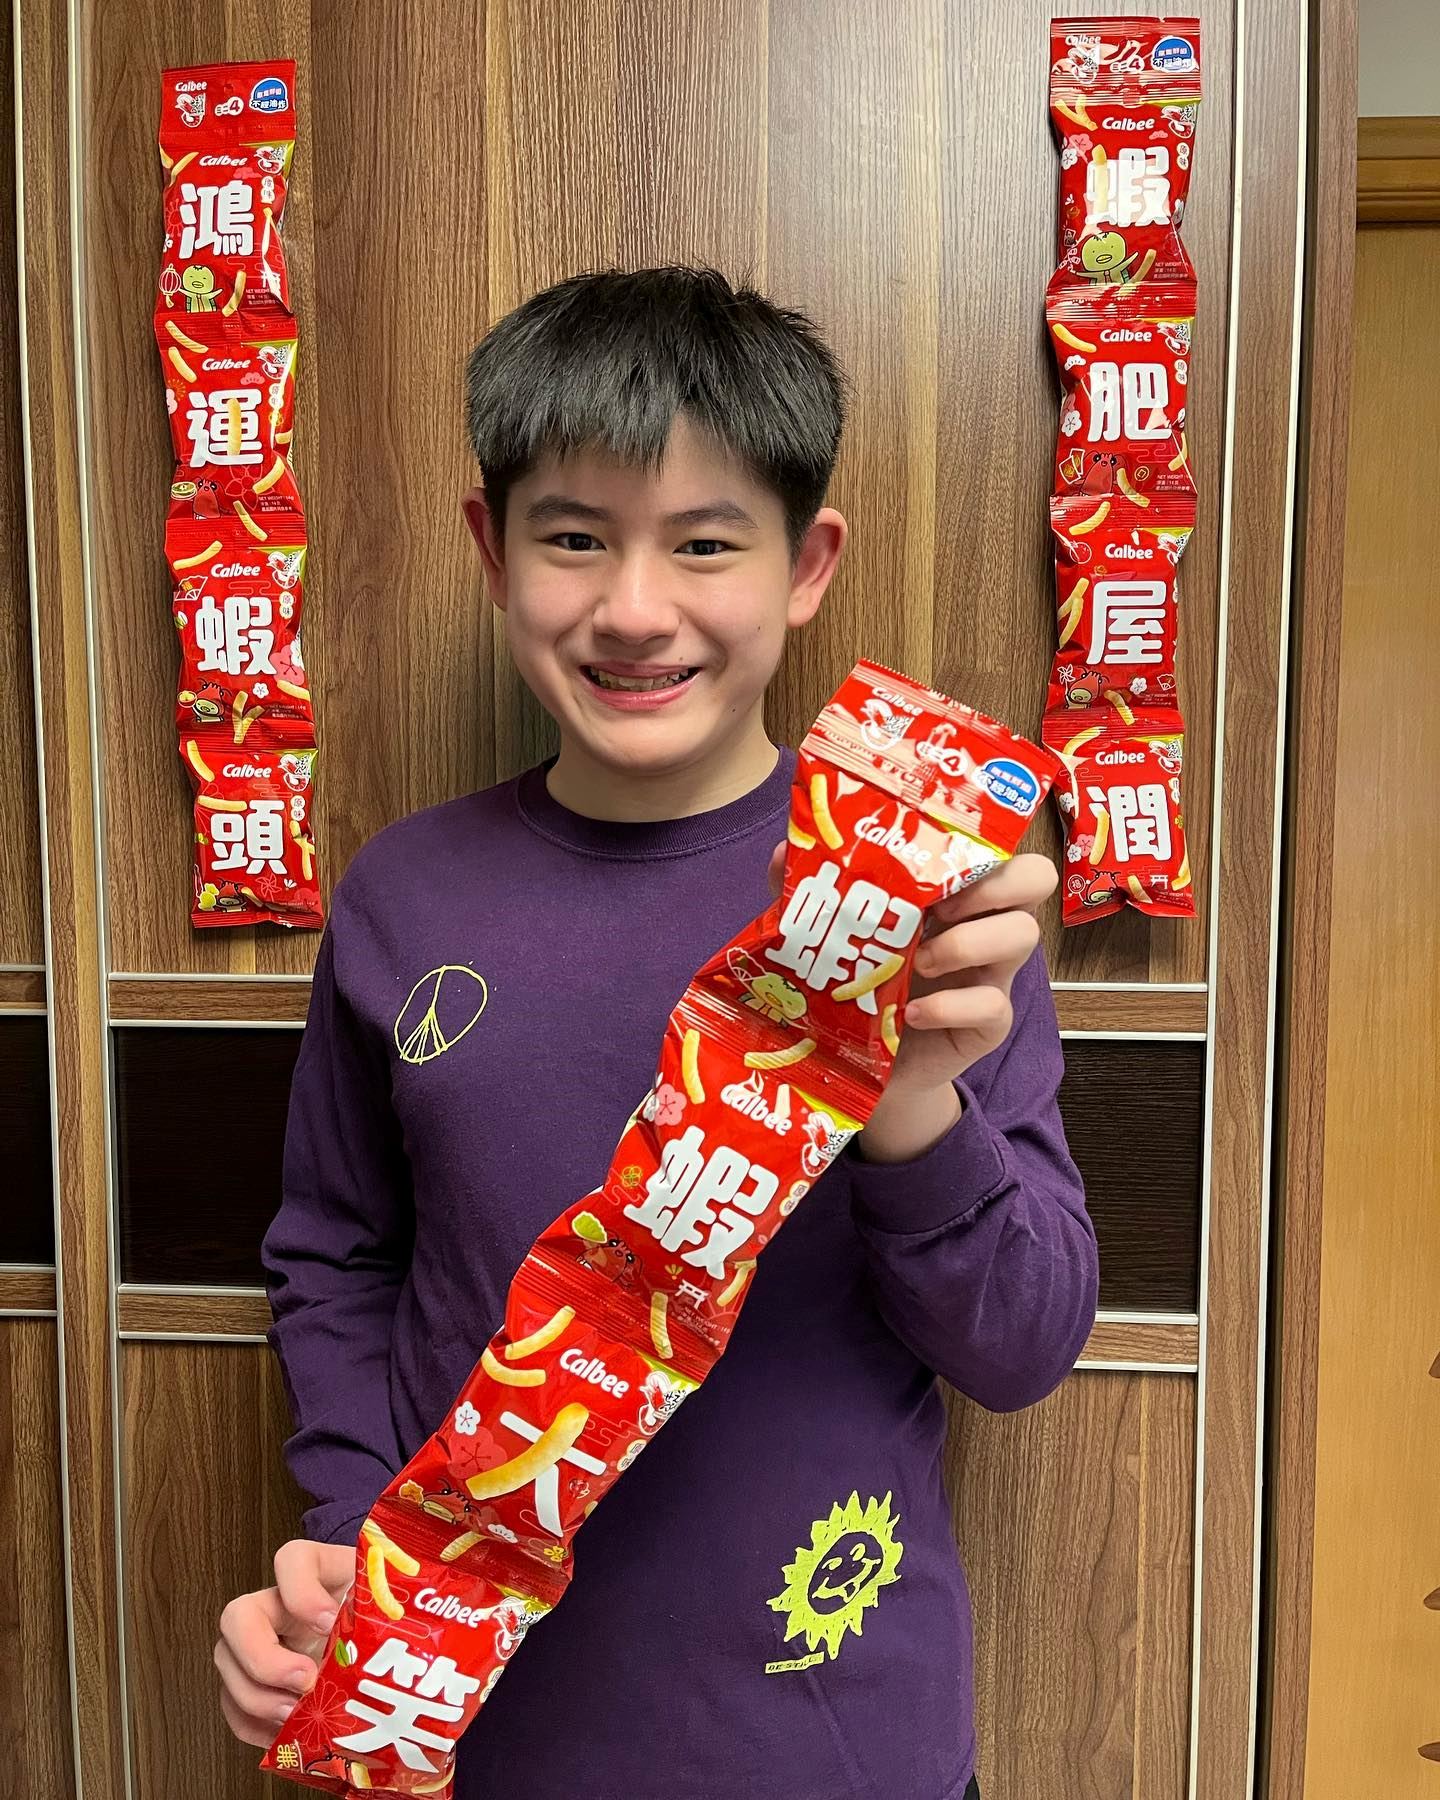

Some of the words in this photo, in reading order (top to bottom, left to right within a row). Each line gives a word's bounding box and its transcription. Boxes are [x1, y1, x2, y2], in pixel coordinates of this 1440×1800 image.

[1065, 35, 1102, 46] Calbee
[175, 80, 208, 92] Calbee
[1102, 117, 1156, 131] Calbee
[199, 155, 248, 167] Calbee
[1085, 144, 1171, 227] 蝦
[178, 180, 255, 260] 鴻
[1100, 329, 1153, 343] Calbee
[201, 357, 251, 371] Calbee
[1087, 362, 1172, 442] 肥
[186, 388, 264, 468] 運
[210, 563, 261, 578] Calbee
[1104, 543, 1153, 560] Calbee
[195, 595, 278, 676] 蝦
[1086, 581, 1167, 665] 屋
[871, 686, 923, 717] Calbee
[222, 764, 273, 779] Calbee
[1095, 751, 1145, 765] Calbee
[198, 795, 288, 875] 頭
[854, 816, 932, 865] Calbee
[1086, 784, 1172, 865] 潤
[765, 860, 923, 1015] 蝦
[720, 1083, 792, 1136] Calbee
[623, 1125, 780, 1280] 蝦
[560, 1348, 630, 1398] Calbee
[466, 1402, 607, 1538] 大
[414, 1588, 482, 1628] Calbee
[332, 1637, 480, 1773] 笑
